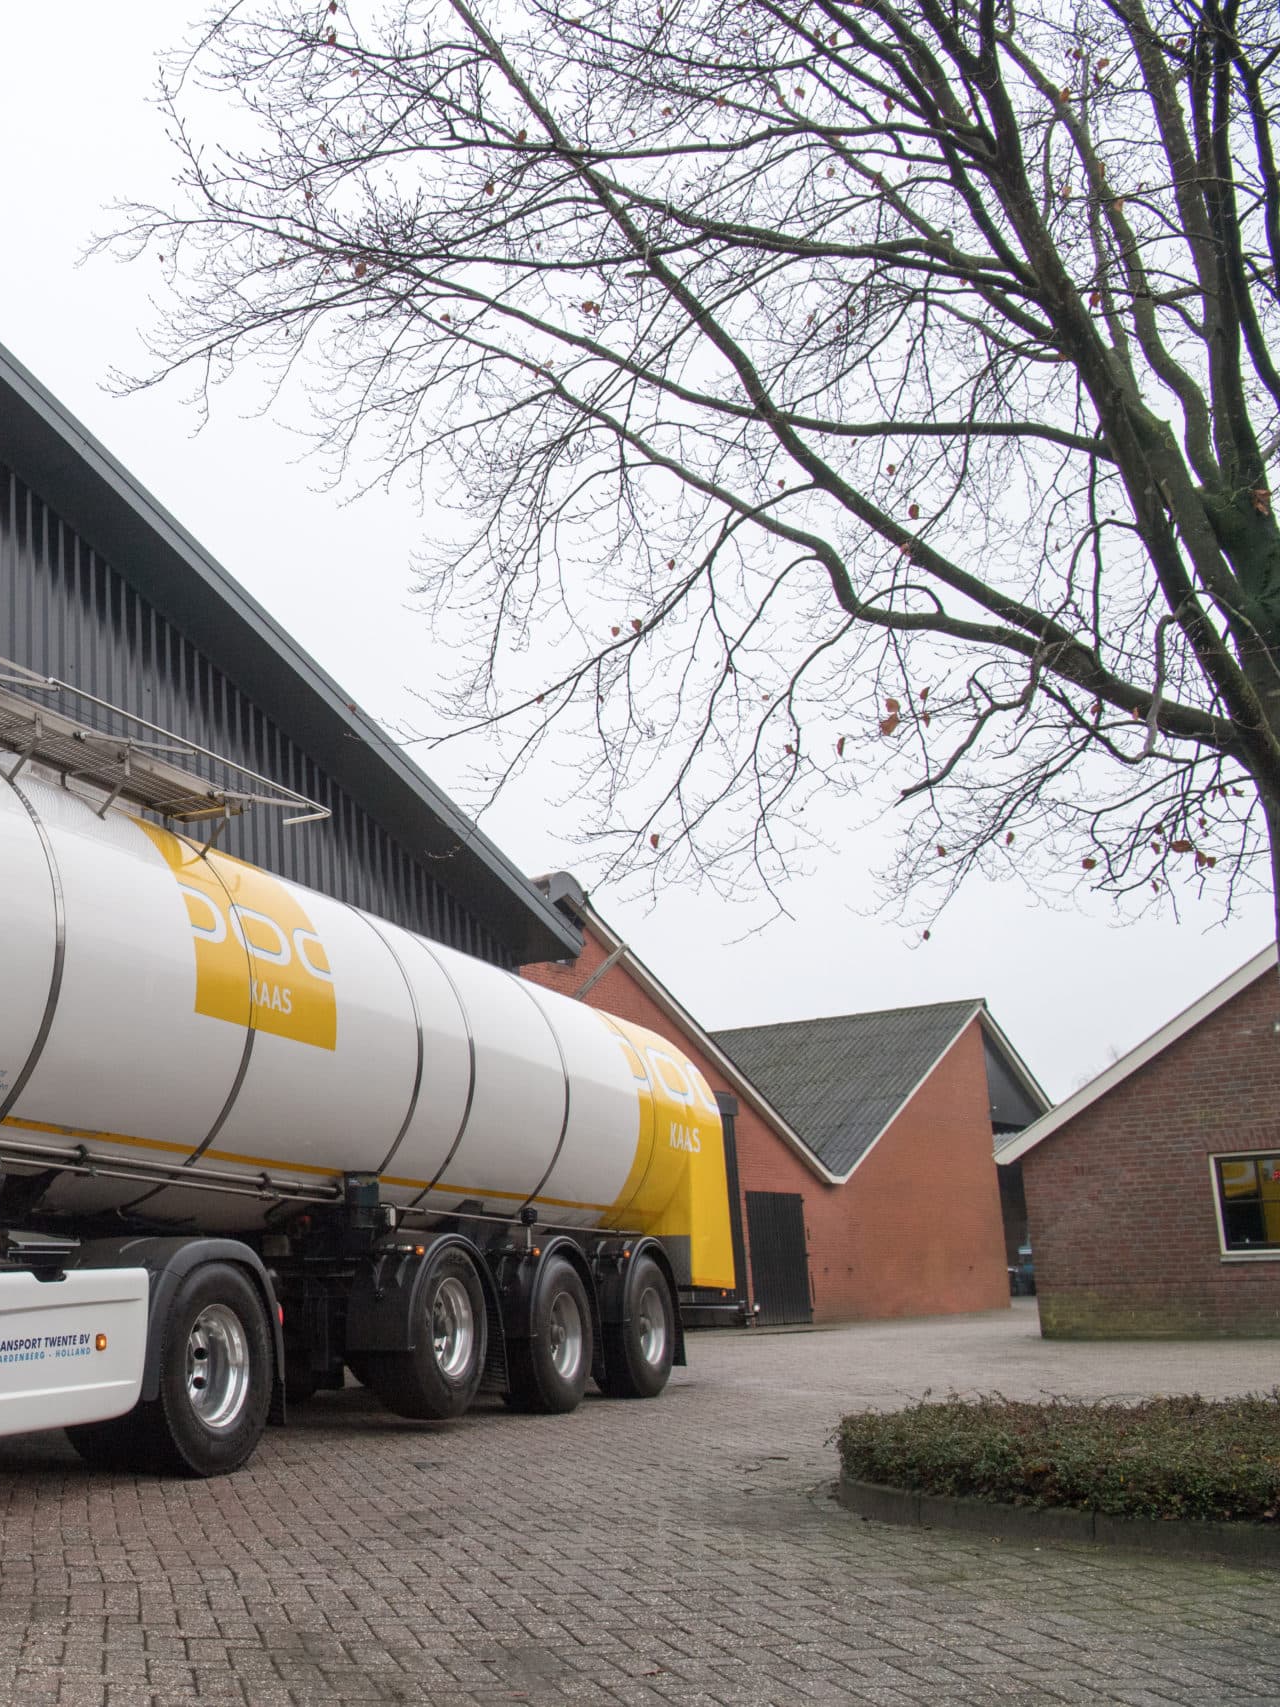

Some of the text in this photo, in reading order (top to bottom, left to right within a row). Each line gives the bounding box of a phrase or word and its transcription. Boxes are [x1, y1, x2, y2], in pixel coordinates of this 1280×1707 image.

[249, 977, 293, 1015] KAAS
[670, 1121, 701, 1152] KAAS
[44, 1333, 78, 1349] TWENTE
[80, 1333, 91, 1345] BV
[55, 1346, 91, 1358] HOLLAND
